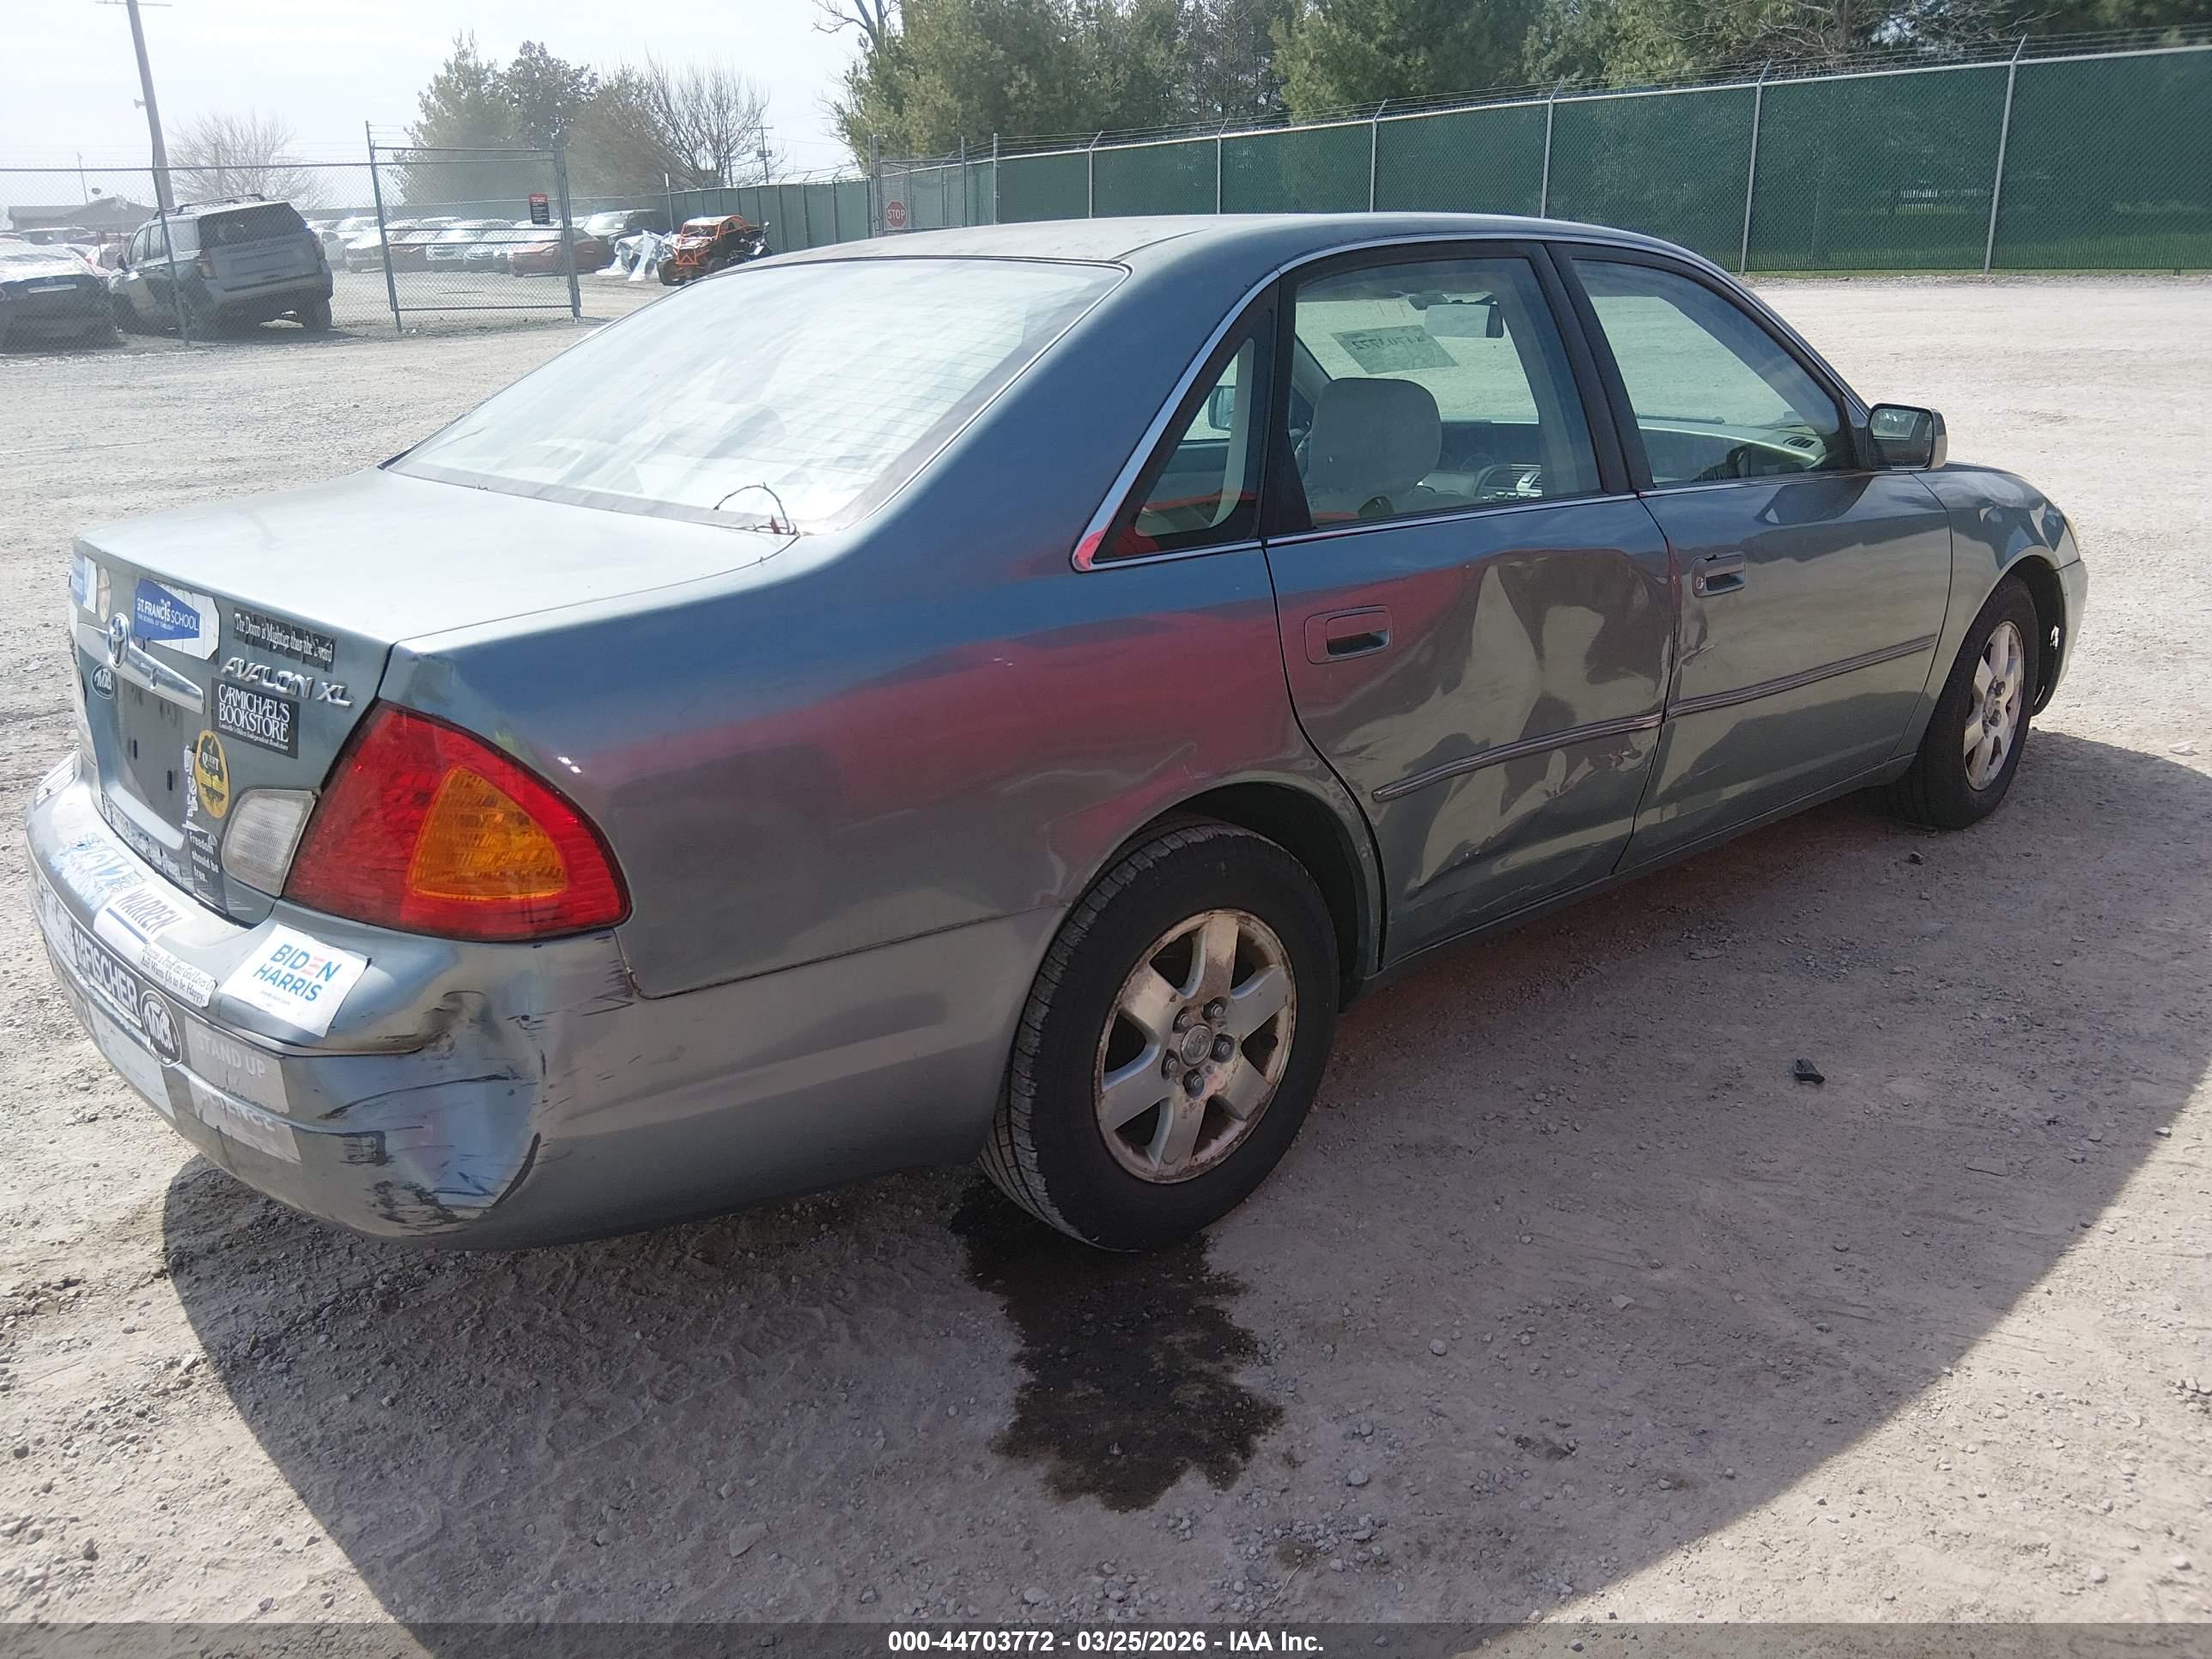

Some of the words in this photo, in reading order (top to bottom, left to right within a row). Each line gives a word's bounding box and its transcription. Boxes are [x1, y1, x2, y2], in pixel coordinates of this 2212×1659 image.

[887, 209, 906, 220] STOP
[144, 599, 171, 623] FRANCIS
[171, 610, 198, 631] SCHOOL
[261, 623, 267, 640] is
[221, 657, 315, 699] AVALON
[316, 682, 353, 707] XL
[219, 702, 289, 743] BOOKSTORE
[191, 850, 210, 866] should
[210, 862, 219, 873] be
[115, 888, 183, 935] WARREN
[270, 944, 343, 981] BIDEN
[252, 963, 323, 1001] HARRIS
[198, 1033, 242, 1069] STAND
[246, 1054, 266, 1079] UP
